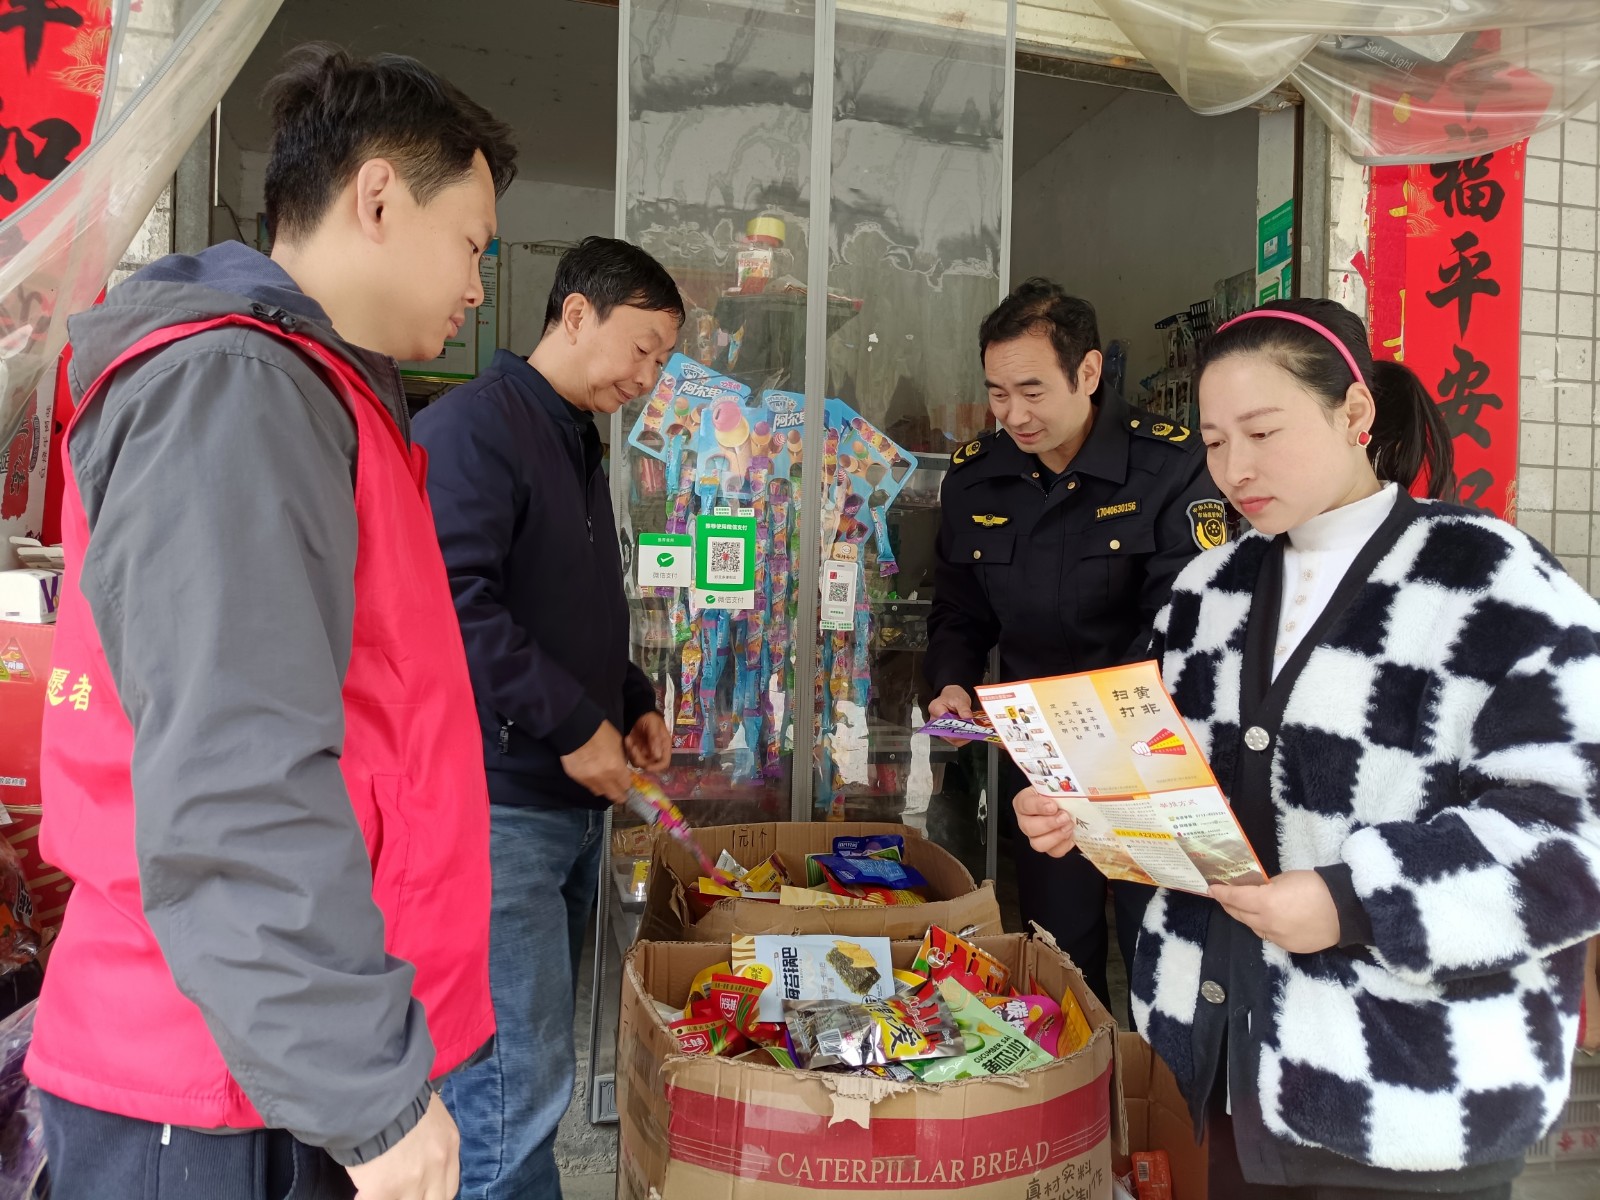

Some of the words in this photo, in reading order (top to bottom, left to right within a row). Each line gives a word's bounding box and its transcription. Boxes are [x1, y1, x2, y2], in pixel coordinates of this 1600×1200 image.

[1364, 41, 1388, 59] Solar
[1391, 52, 1415, 71] Light
[1096, 501, 1136, 519] 17040630156
[717, 596, 744, 604] 微信支付
[1112, 686, 1151, 701] 扫黄
[1119, 703, 1160, 718] 打非
[974, 1042, 1004, 1063] CUCUMBER
[777, 1152, 966, 1184] CATERPILLAR
[971, 1141, 1050, 1180] BREAD
[1026, 1160, 1092, 1200] 真材实料
[1049, 1168, 1103, 1200] 心制作
